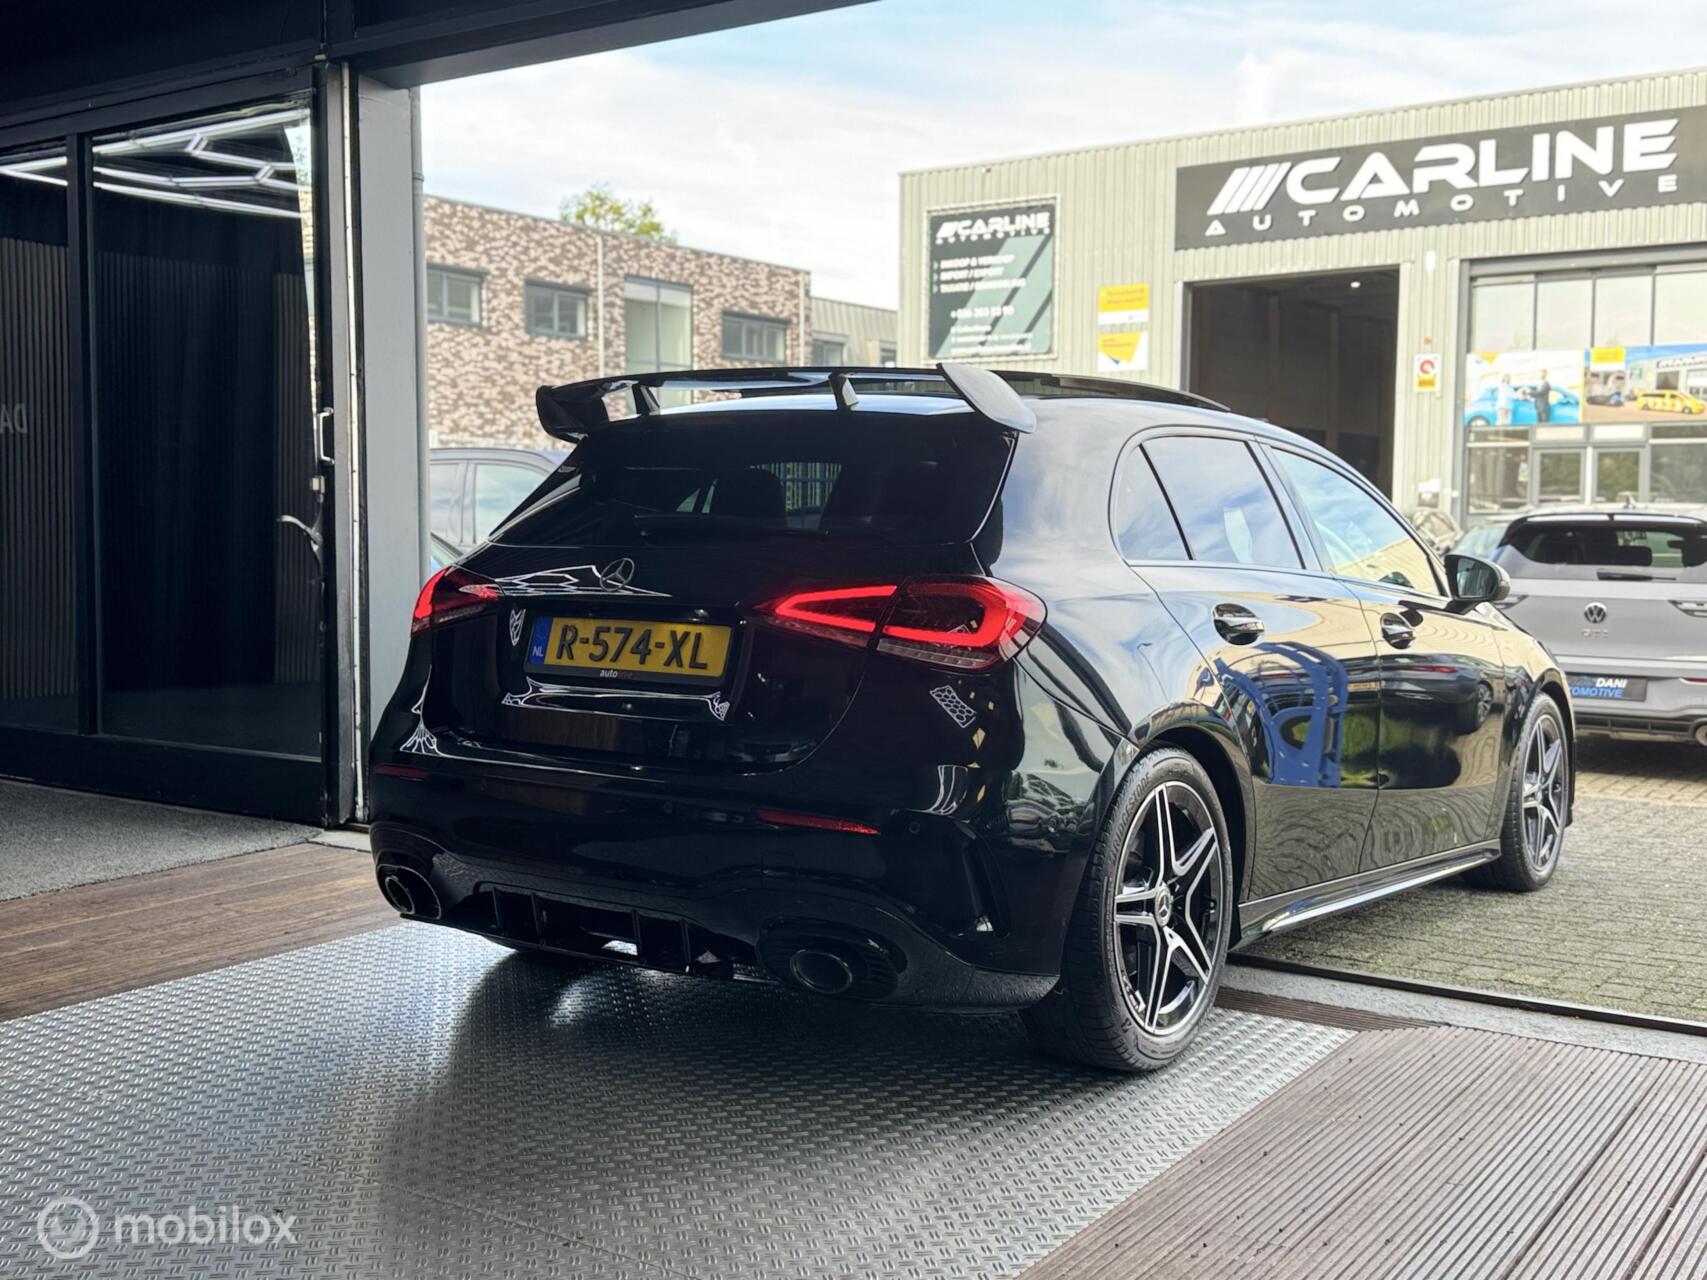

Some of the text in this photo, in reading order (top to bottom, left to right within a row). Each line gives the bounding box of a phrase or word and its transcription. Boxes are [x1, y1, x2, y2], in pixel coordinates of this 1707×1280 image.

[1286, 118, 1678, 205] CARLINE
[956, 211, 1050, 236] CARLINE
[1205, 175, 1678, 236] AUTOMOTIVE
[532, 645, 544, 657] NL
[555, 623, 708, 670] R-574-XL
[1595, 677, 1628, 688] DANI
